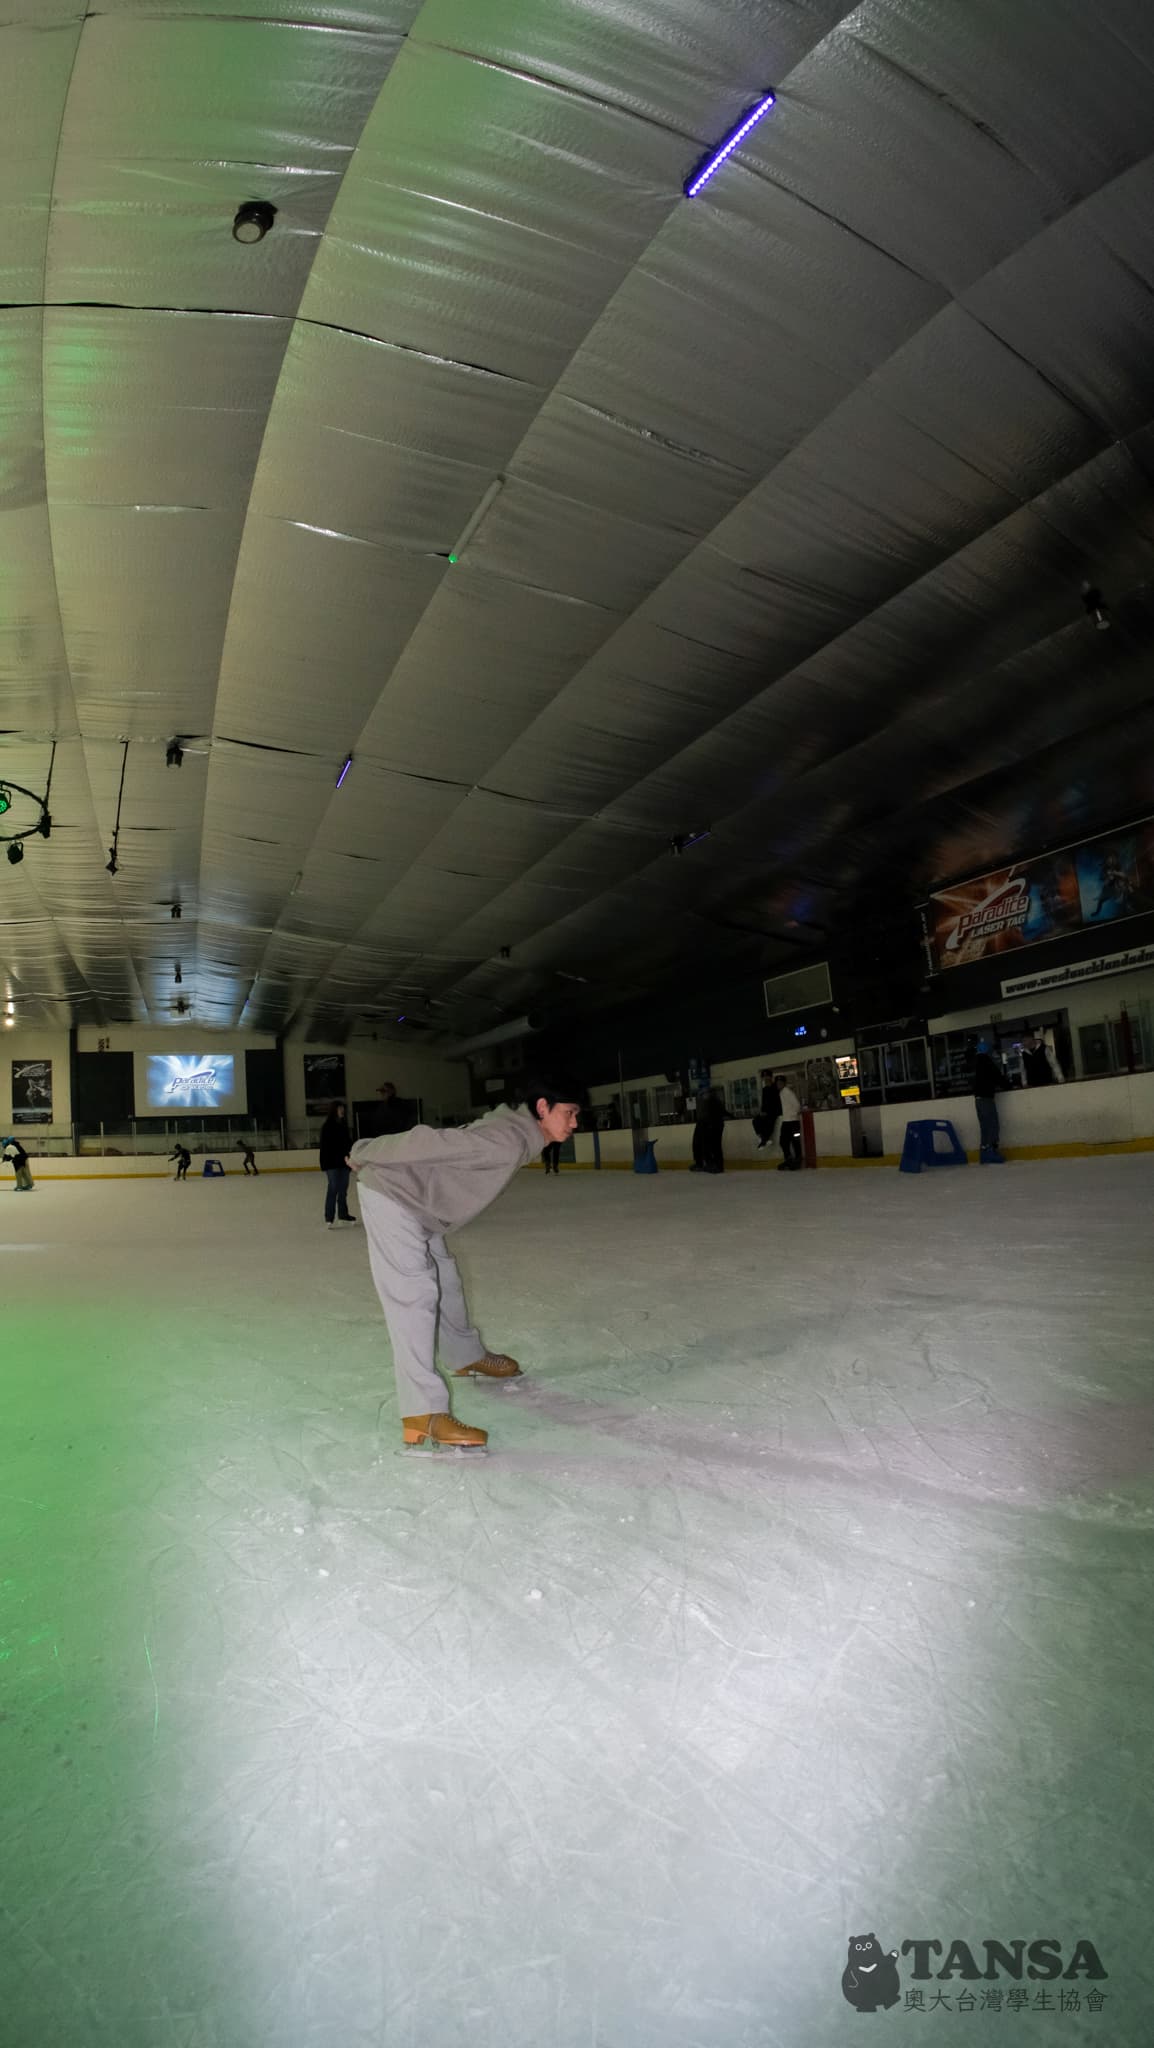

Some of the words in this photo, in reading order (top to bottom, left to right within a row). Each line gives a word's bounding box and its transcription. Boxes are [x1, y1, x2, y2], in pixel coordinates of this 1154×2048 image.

[957, 896, 1030, 937] Paradice
[970, 919, 1006, 937] LASER
[1006, 915, 1026, 928] TAG
